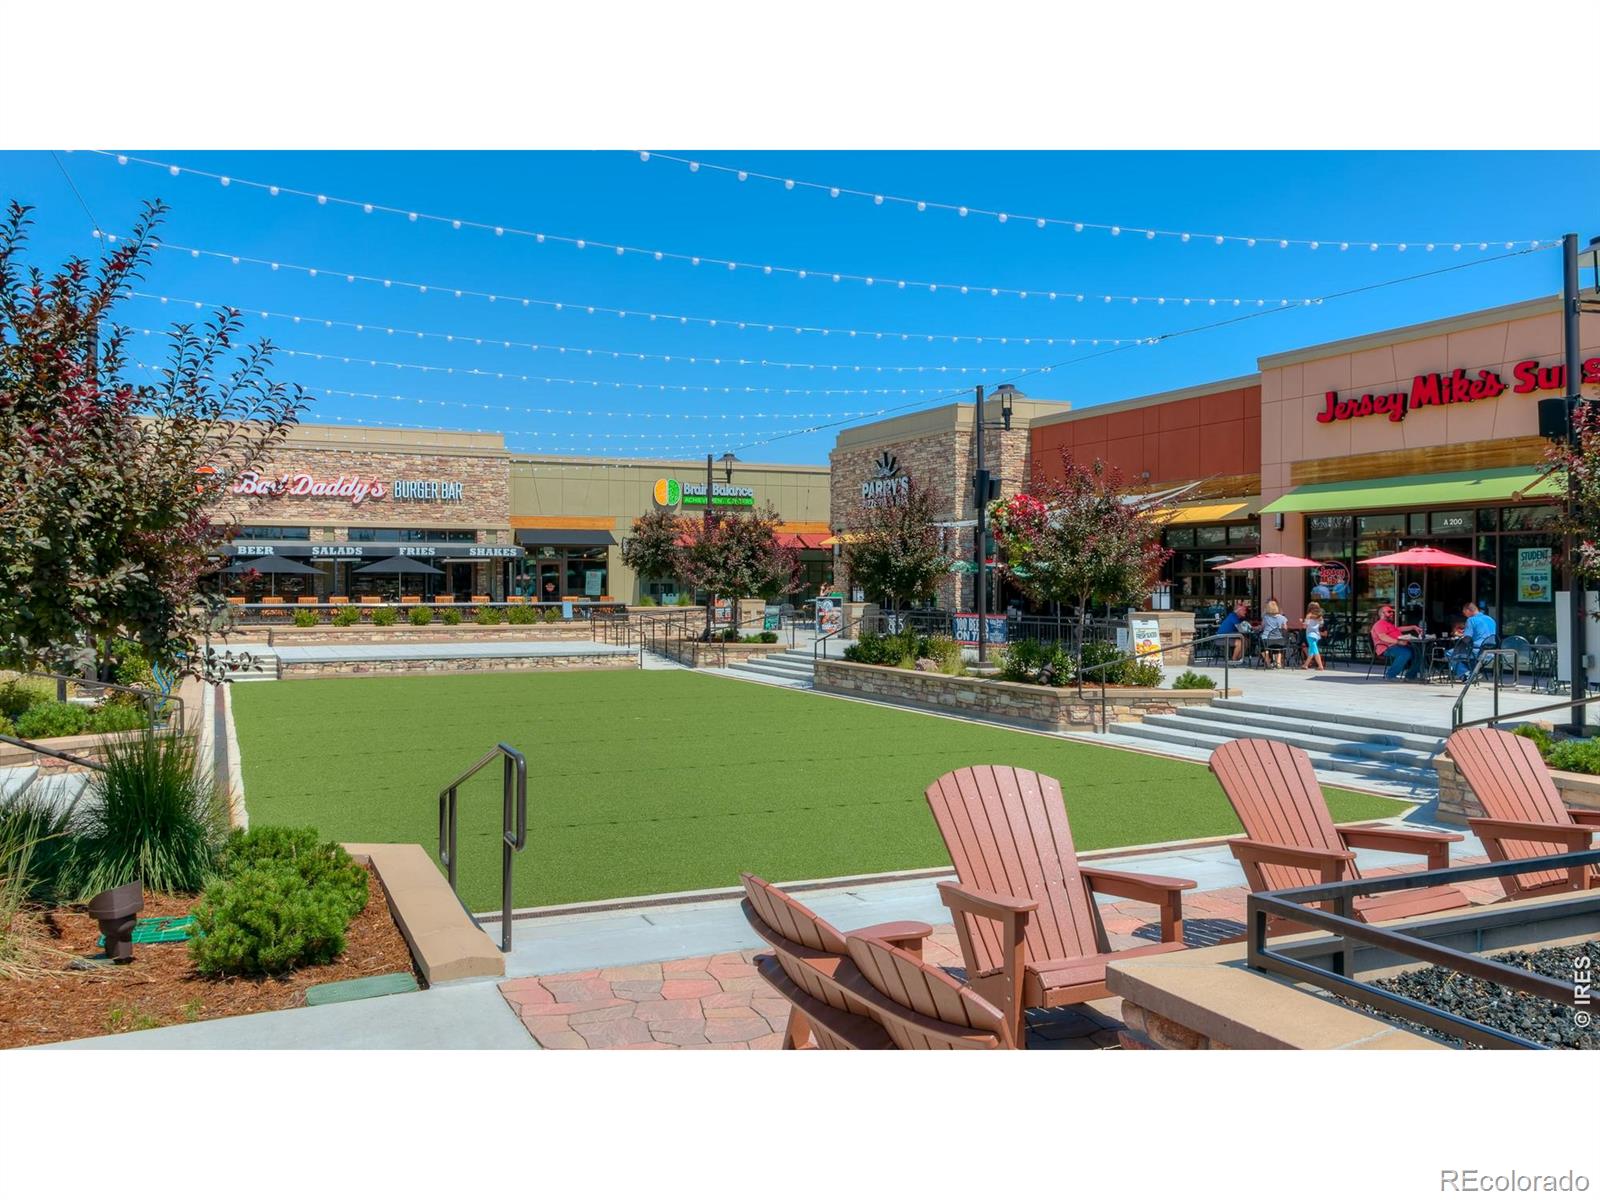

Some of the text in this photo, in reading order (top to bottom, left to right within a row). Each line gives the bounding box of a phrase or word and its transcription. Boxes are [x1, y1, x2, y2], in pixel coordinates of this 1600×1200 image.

[1316, 357, 1600, 424] Jersey Mike's Sus
[289, 472, 388, 504] Daddy's
[393, 480, 464, 501] BURGER BAR
[712, 483, 754, 497] Balance
[1449, 517, 1463, 526] 200
[237, 546, 275, 556] BEER
[311, 546, 363, 556] SALADS
[399, 547, 436, 556] FRIES
[469, 548, 518, 557] SHAKES
[956, 630, 970, 641] ON
